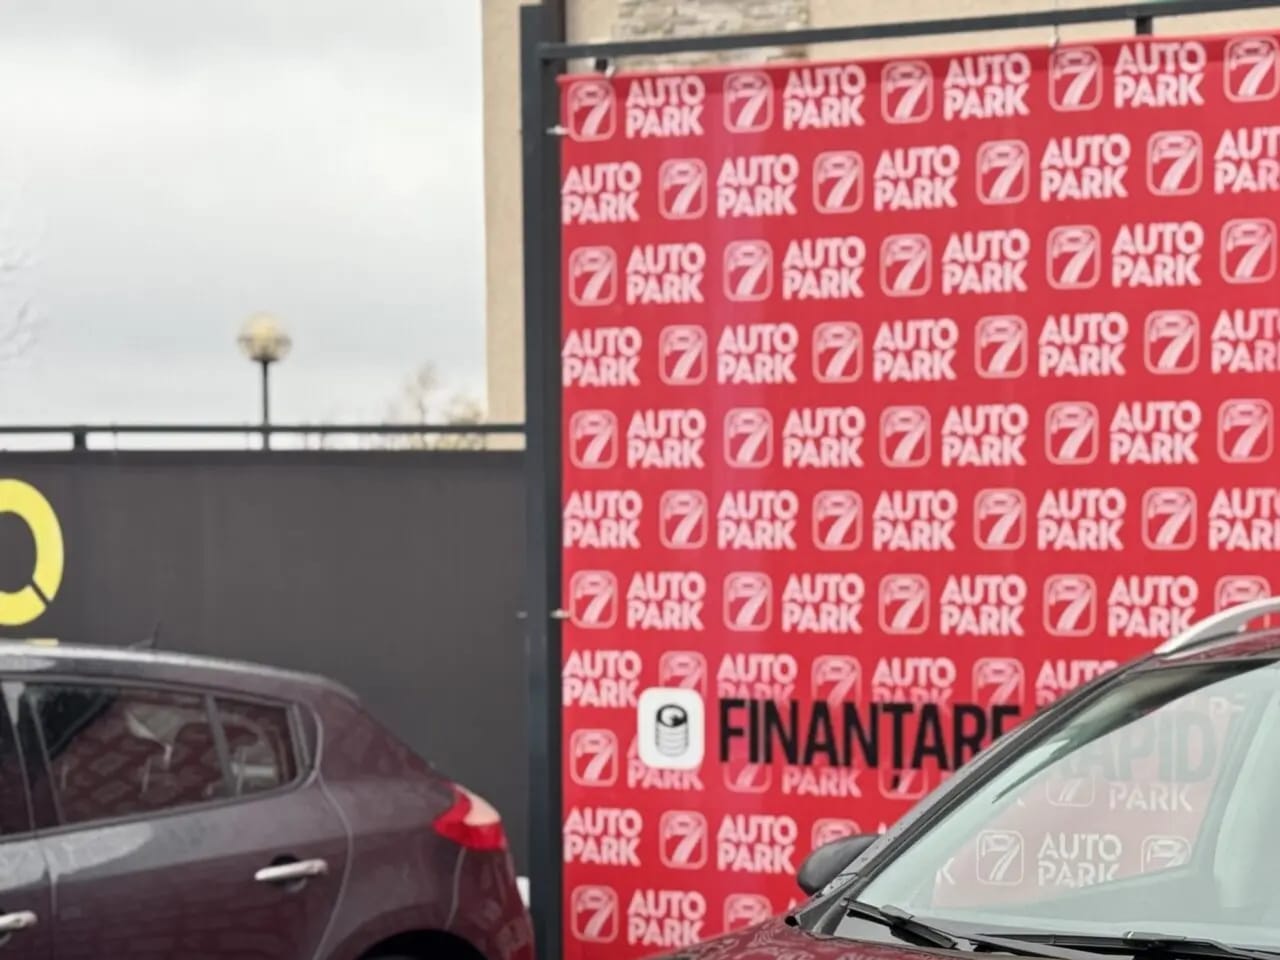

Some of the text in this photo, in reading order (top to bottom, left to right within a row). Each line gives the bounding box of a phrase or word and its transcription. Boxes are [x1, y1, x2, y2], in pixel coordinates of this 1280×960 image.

[945, 53, 1031, 89] AUTO
[1114, 42, 1205, 77] AUTO
[627, 75, 705, 109] AUTO
[784, 65, 865, 98] AUTO
[1114, 73, 1205, 107] PARK
[784, 96, 863, 130] PARK
[944, 84, 1028, 120] PARK
[626, 104, 704, 138] PARK
[875, 146, 959, 180] AUTO
[1041, 134, 1130, 168] AUTO
[564, 162, 640, 194] AUTO
[718, 155, 798, 187] AUTO
[1041, 165, 1128, 201] PARK
[563, 189, 639, 224] PARK
[717, 184, 797, 218] PARK
[874, 177, 957, 211] PARK
[784, 237, 864, 269] AUTO
[944, 229, 1029, 264] AUTO
[1113, 222, 1203, 256] AUTO
[627, 244, 705, 274] AUTO
[1112, 252, 1201, 288] PARK
[627, 272, 704, 304] PARK
[782, 266, 862, 299] PARK
[942, 259, 1027, 294] PARK
[564, 328, 641, 359] AUTO
[718, 324, 798, 353] AUTO
[874, 319, 958, 351] AUTO
[1039, 313, 1127, 347] AUTO
[563, 355, 640, 386] PARK
[717, 351, 796, 384] PARK
[873, 348, 956, 382] PARK
[1038, 342, 1126, 376] PARK
[628, 410, 705, 438] AUTO
[784, 407, 864, 436] AUTO
[944, 403, 1028, 437] AUTO
[1110, 401, 1200, 435] AUTO
[628, 436, 704, 468] PARK
[783, 434, 862, 467] PARK
[942, 432, 1026, 466] PARK
[1109, 430, 1198, 466] PARK
[564, 491, 641, 519] AUTO
[718, 491, 798, 520] AUTO
[874, 490, 957, 522] AUTO
[1039, 488, 1125, 522] AUTO
[564, 518, 640, 549] PARK
[717, 518, 796, 551] PARK
[873, 518, 955, 551] PARK
[1038, 518, 1123, 551] PARK
[628, 573, 705, 600] AUTO
[783, 573, 864, 602] AUTO
[942, 575, 1026, 607] AUTO
[1109, 576, 1197, 608] AUTO
[627, 599, 704, 630] PARK
[782, 600, 862, 633] PARK
[940, 602, 1024, 635] PARK
[1108, 605, 1195, 638] PARK
[564, 651, 641, 678] AUTO
[718, 655, 797, 683] AUTO
[874, 658, 955, 686] AUTO
[563, 676, 638, 707] PARK
[564, 809, 641, 836] AUTO
[718, 816, 797, 844] AUTO
[564, 835, 639, 866] PARK
[717, 841, 794, 874] PARK
[628, 891, 705, 919] AUTO
